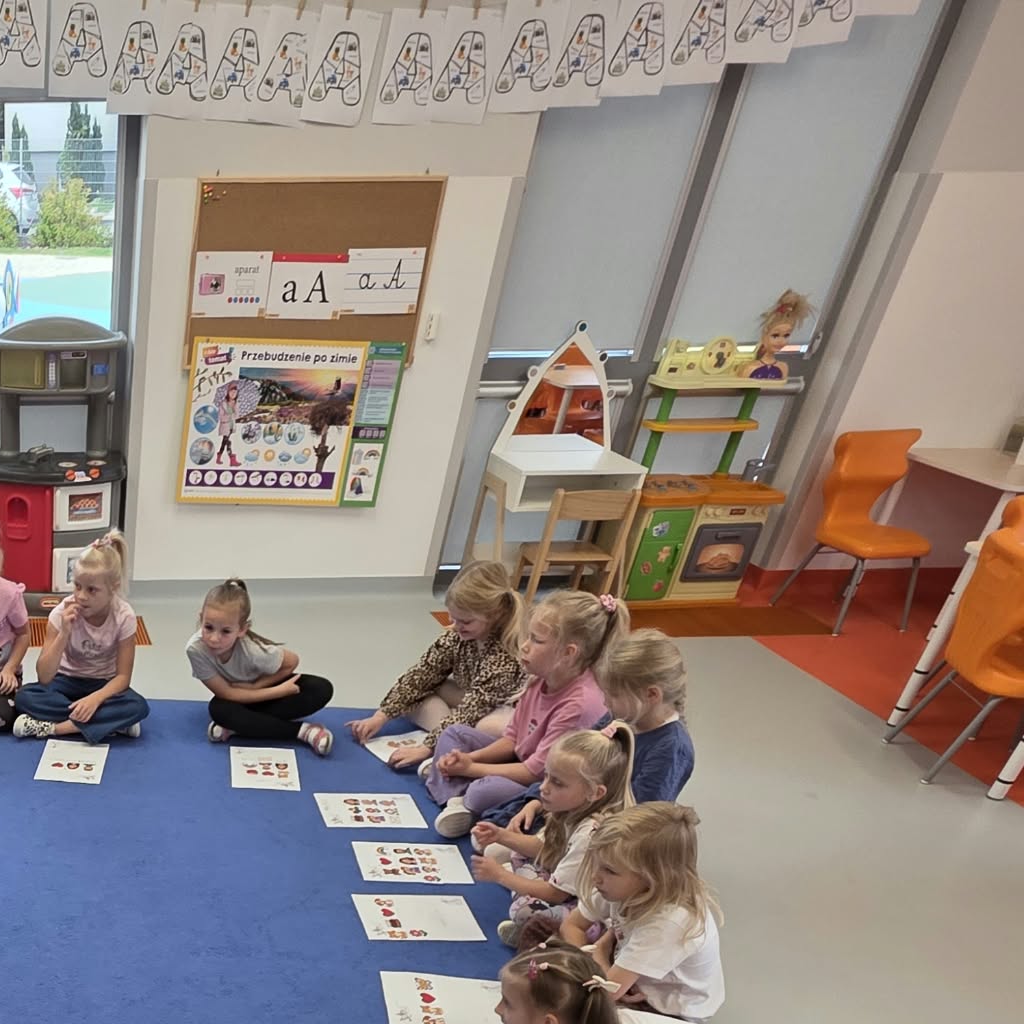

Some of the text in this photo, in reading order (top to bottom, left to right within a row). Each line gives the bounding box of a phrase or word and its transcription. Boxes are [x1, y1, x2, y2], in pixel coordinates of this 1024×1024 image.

[53, 2, 108, 78] A
[109, 20, 159, 95] A
[155, 22, 209, 101] A
[210, 27, 261, 102] A
[257, 31, 309, 108] A
[308, 31, 362, 106] A
[379, 32, 433, 106] A
[432, 30, 486, 104] A
[495, 19, 553, 93] A
[552, 14, 606, 87] A
[608, 2, 665, 76] A
[671, 0, 726, 65] A
[234, 265, 260, 276] aparat
[241, 350, 311, 363] Przebudzenie
[313, 353, 328, 365] po
[330, 353, 358, 364] zimie
